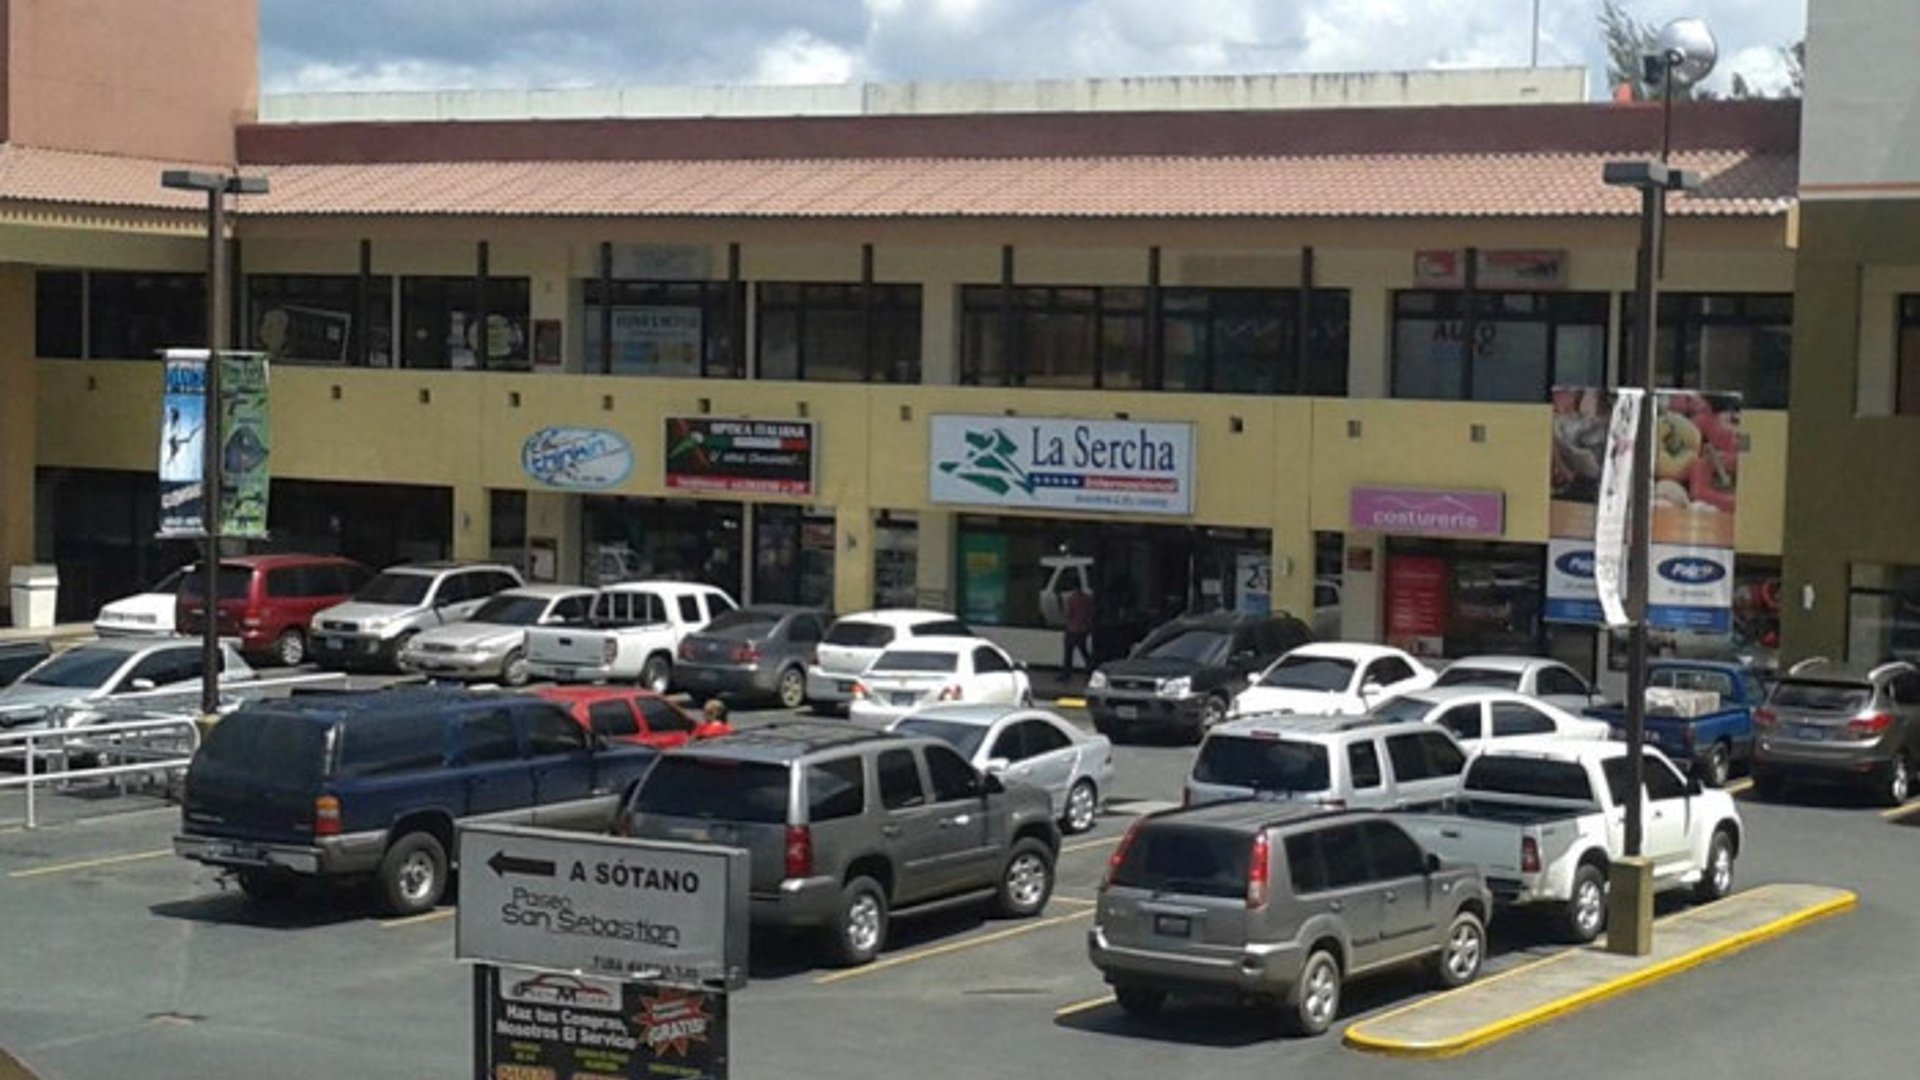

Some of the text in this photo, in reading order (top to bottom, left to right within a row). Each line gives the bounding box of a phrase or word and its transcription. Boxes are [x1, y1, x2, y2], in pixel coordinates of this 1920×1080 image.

[1433, 320, 1496, 341] AUO
[1031, 425, 1175, 471] La Sercha
[569, 858, 699, 893] A SÓTANO
[512, 887, 572, 909] Paseo
[502, 903, 680, 943] San Sebastian
[580, 1028, 638, 1050] Servicio
